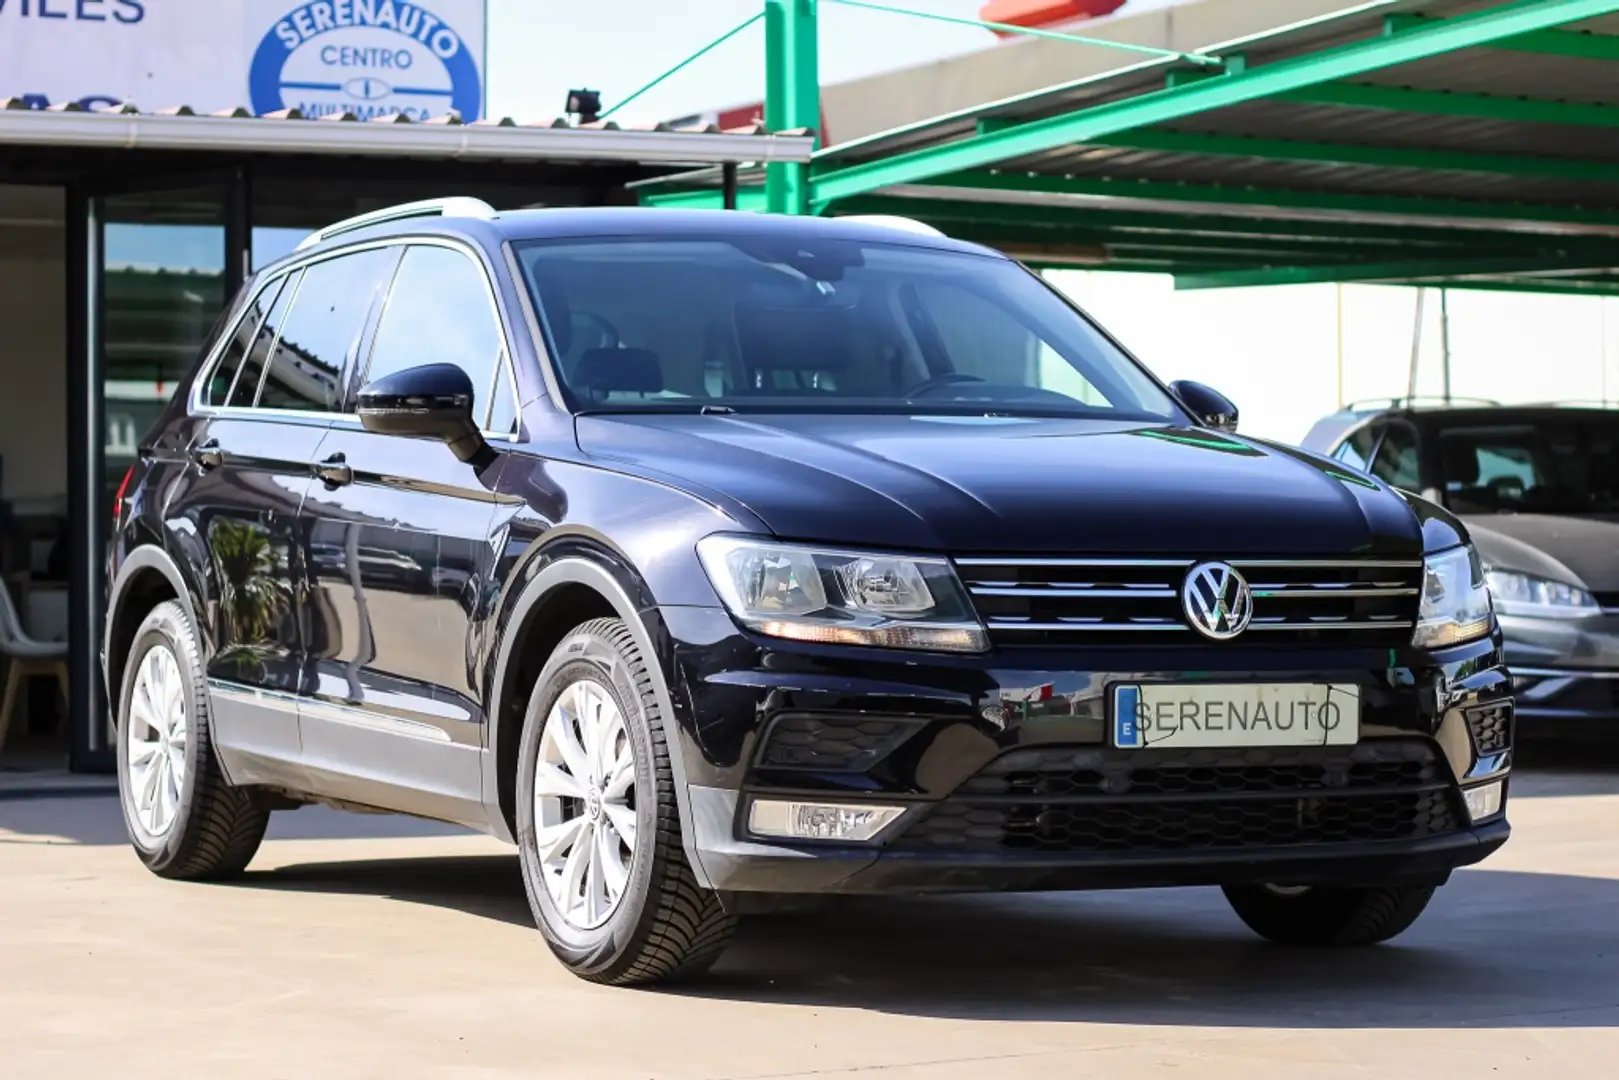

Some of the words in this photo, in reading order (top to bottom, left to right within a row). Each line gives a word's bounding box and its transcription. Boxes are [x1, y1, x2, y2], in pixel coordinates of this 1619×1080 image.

[0, 0, 145, 24] ILES
[275, 0, 459, 59] SERENAUTO
[320, 45, 413, 70] CENTRO
[1123, 722, 1132, 736] E
